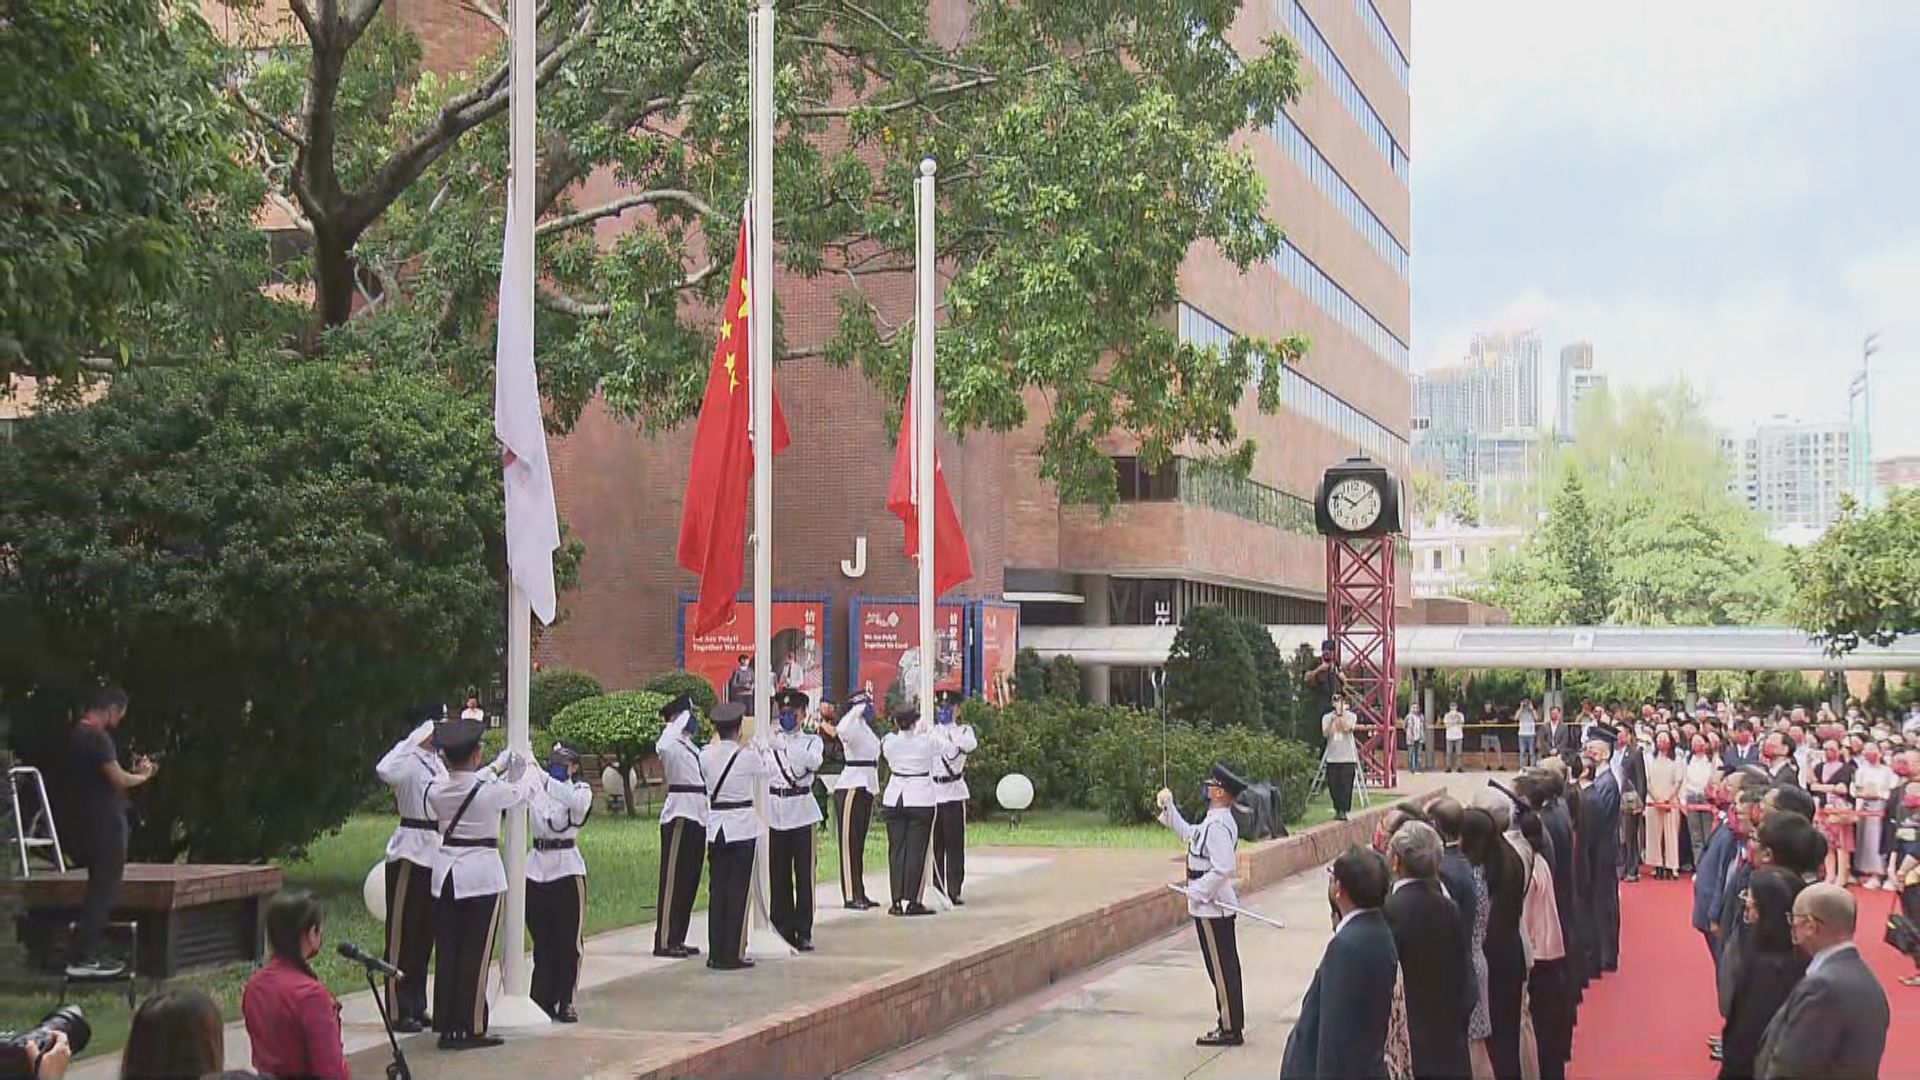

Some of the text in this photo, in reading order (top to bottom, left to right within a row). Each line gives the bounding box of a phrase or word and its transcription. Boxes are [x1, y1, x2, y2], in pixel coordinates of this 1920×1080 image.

[841, 536, 867, 577] J
[693, 643, 723, 653] Together
[724, 643, 736, 651] We
[864, 641, 886, 650] Together
